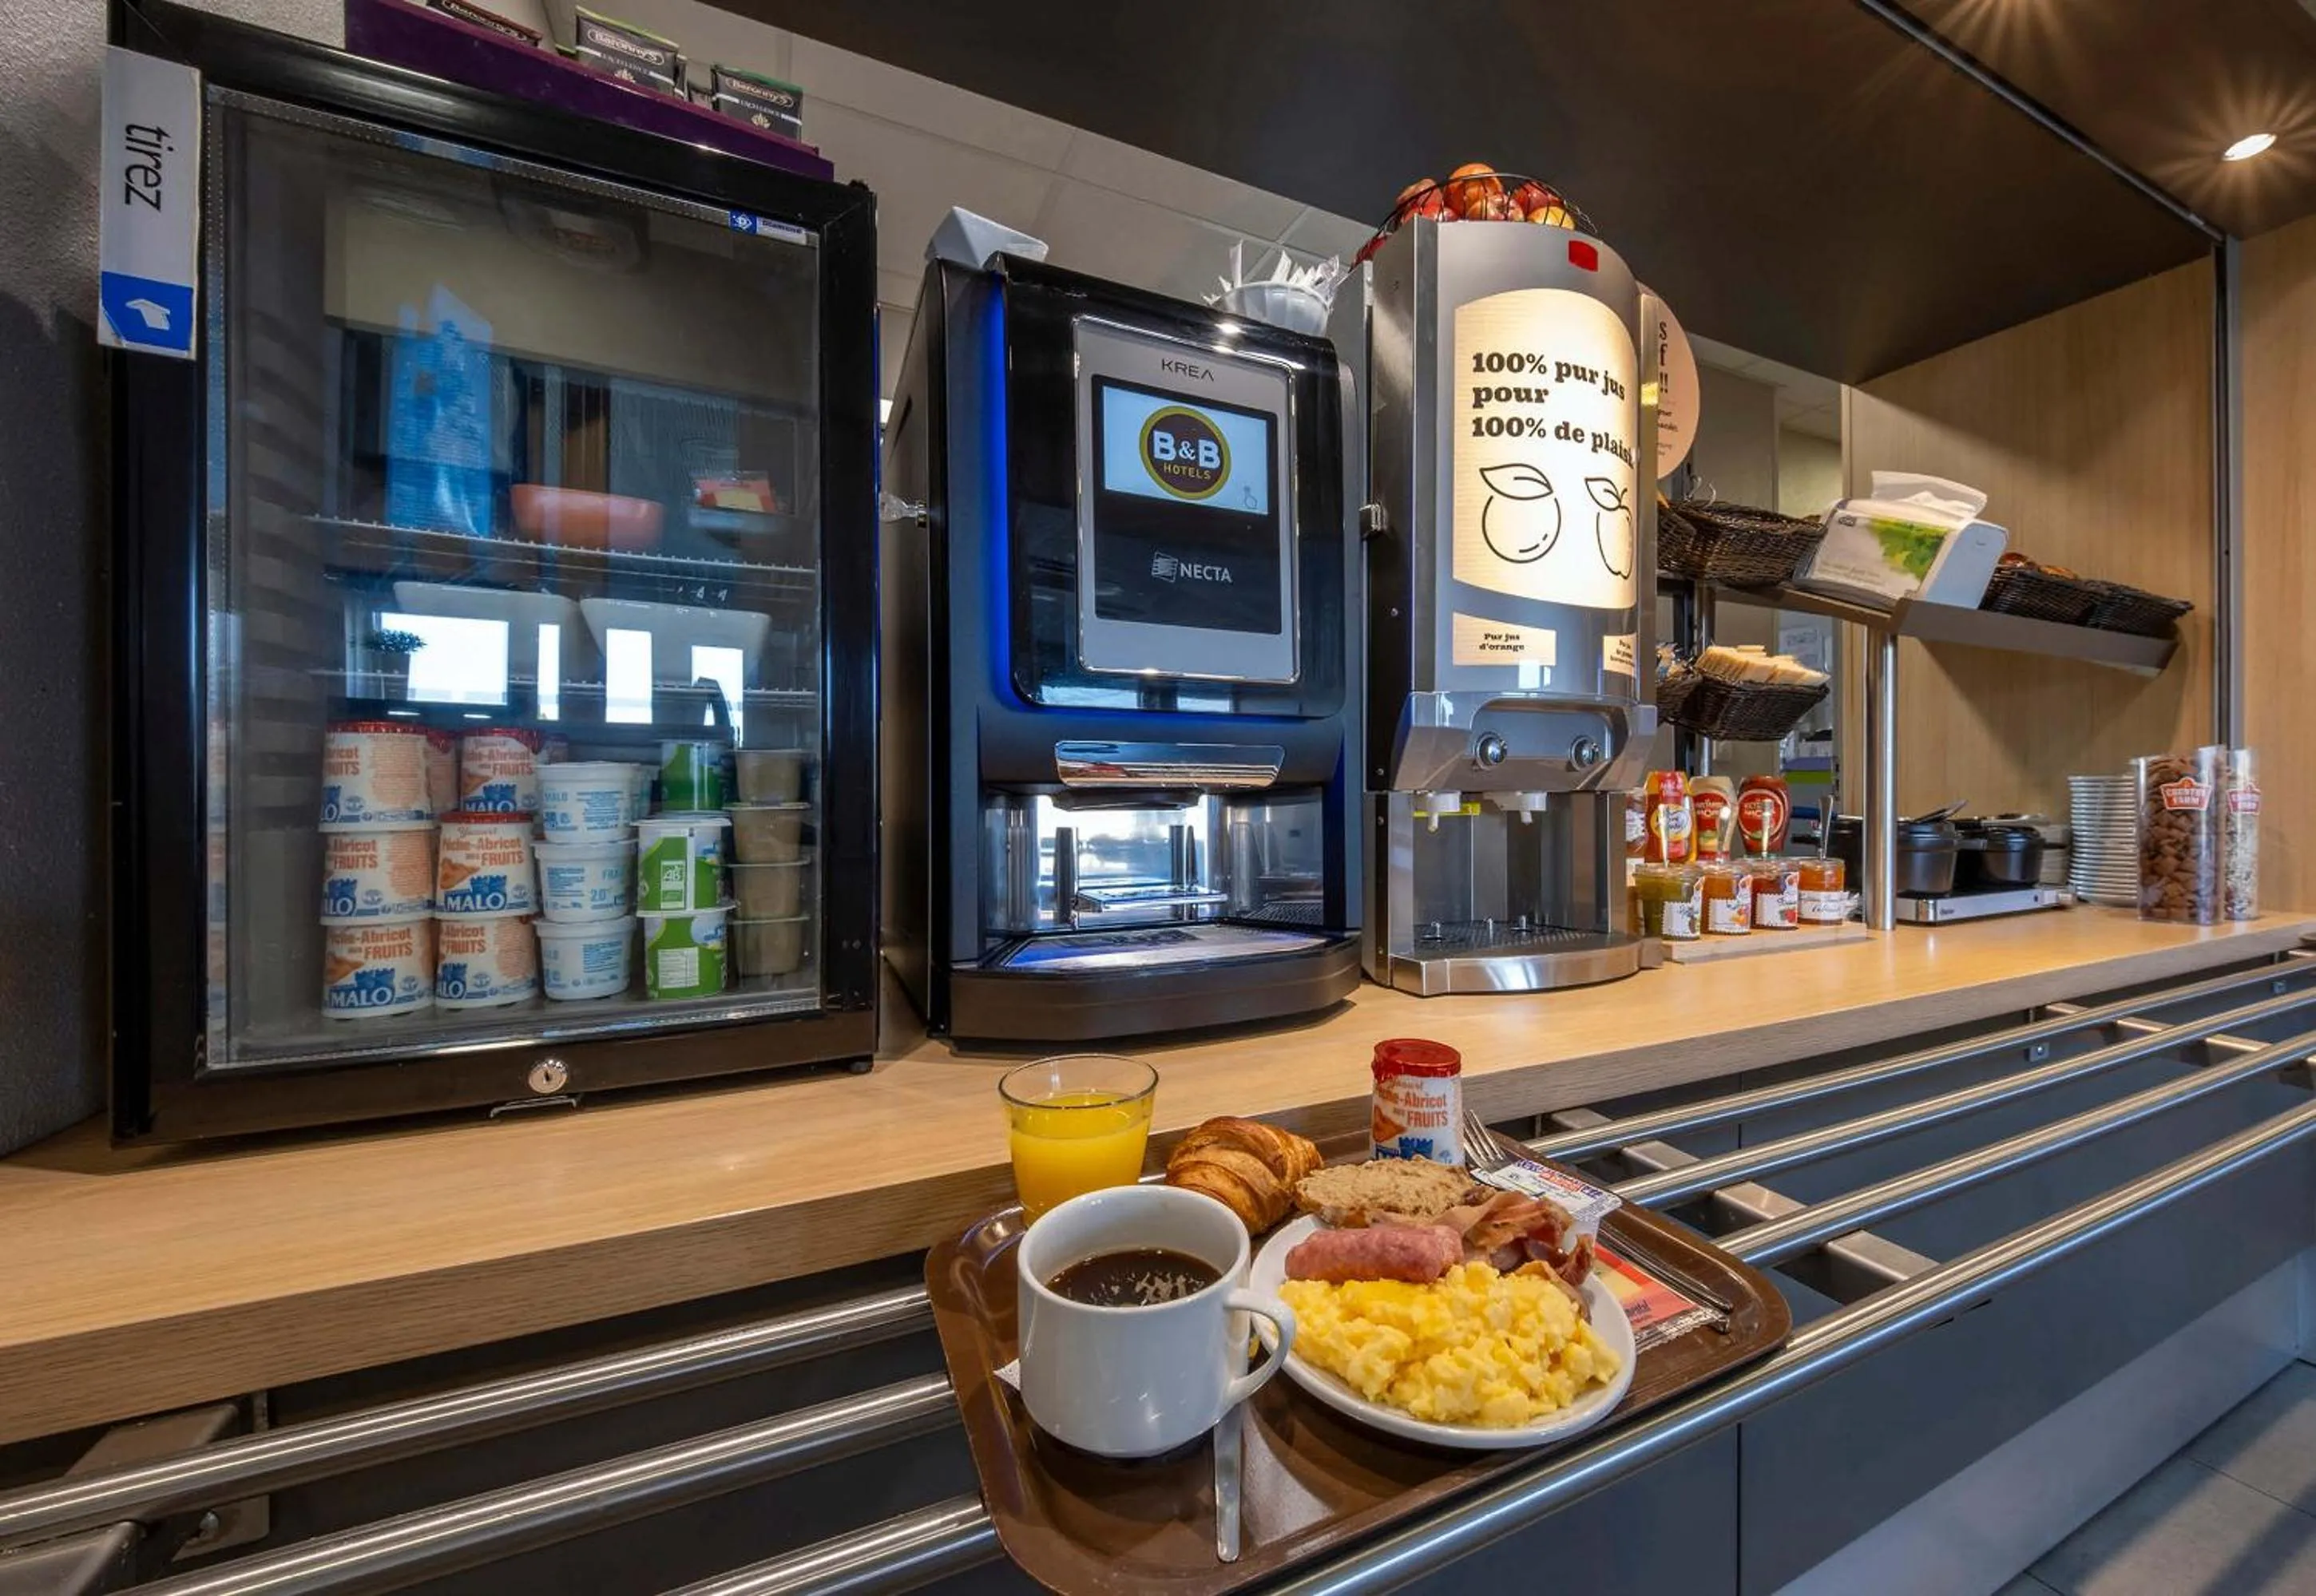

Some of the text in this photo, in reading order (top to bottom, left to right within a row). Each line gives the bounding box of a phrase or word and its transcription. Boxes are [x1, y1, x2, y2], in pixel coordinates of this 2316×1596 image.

[125, 122, 174, 212] tirez
[1161, 358, 1215, 382] KREA
[1472, 352, 1625, 401] 100% pur jus
[1472, 386, 1549, 410] pour
[1472, 416, 1547, 438] 100%
[1554, 421, 1585, 444] de
[1152, 431, 1220, 469] B&B
[1163, 462, 1212, 480] HOTELS
[1180, 562, 1233, 583] NECTA
[1484, 632, 1521, 642] Pur jus
[1478, 643, 1525, 652] d'orange
[481, 850, 525, 866] FRUITS
[447, 891, 505, 911] MALO
[364, 943, 414, 960] FRUITS
[331, 987, 393, 1007] MALO
[1407, 1111, 1448, 1127] FRUITS
